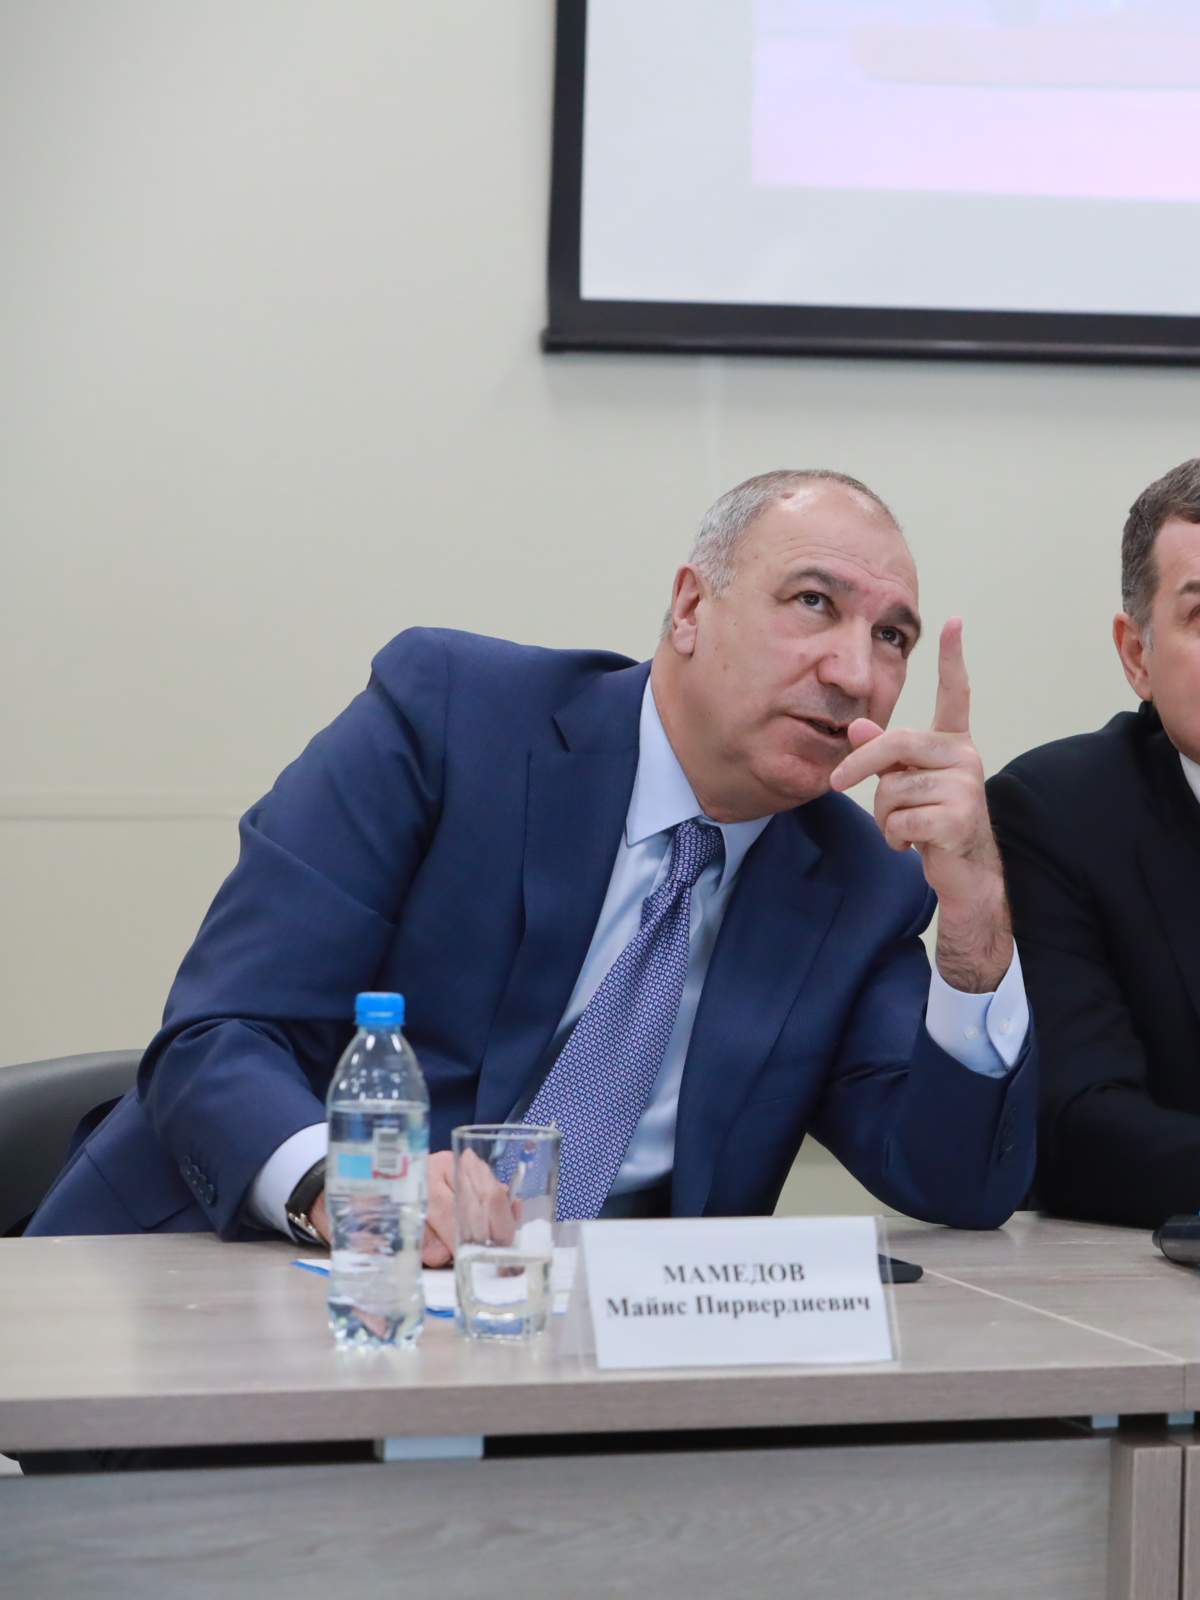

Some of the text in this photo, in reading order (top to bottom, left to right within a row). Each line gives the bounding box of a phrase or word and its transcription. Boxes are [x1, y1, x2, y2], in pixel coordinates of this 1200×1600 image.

[663, 1262, 806, 1285] МАМЕДОВ
[606, 1294, 871, 1319] Майис Пирвердиевич
